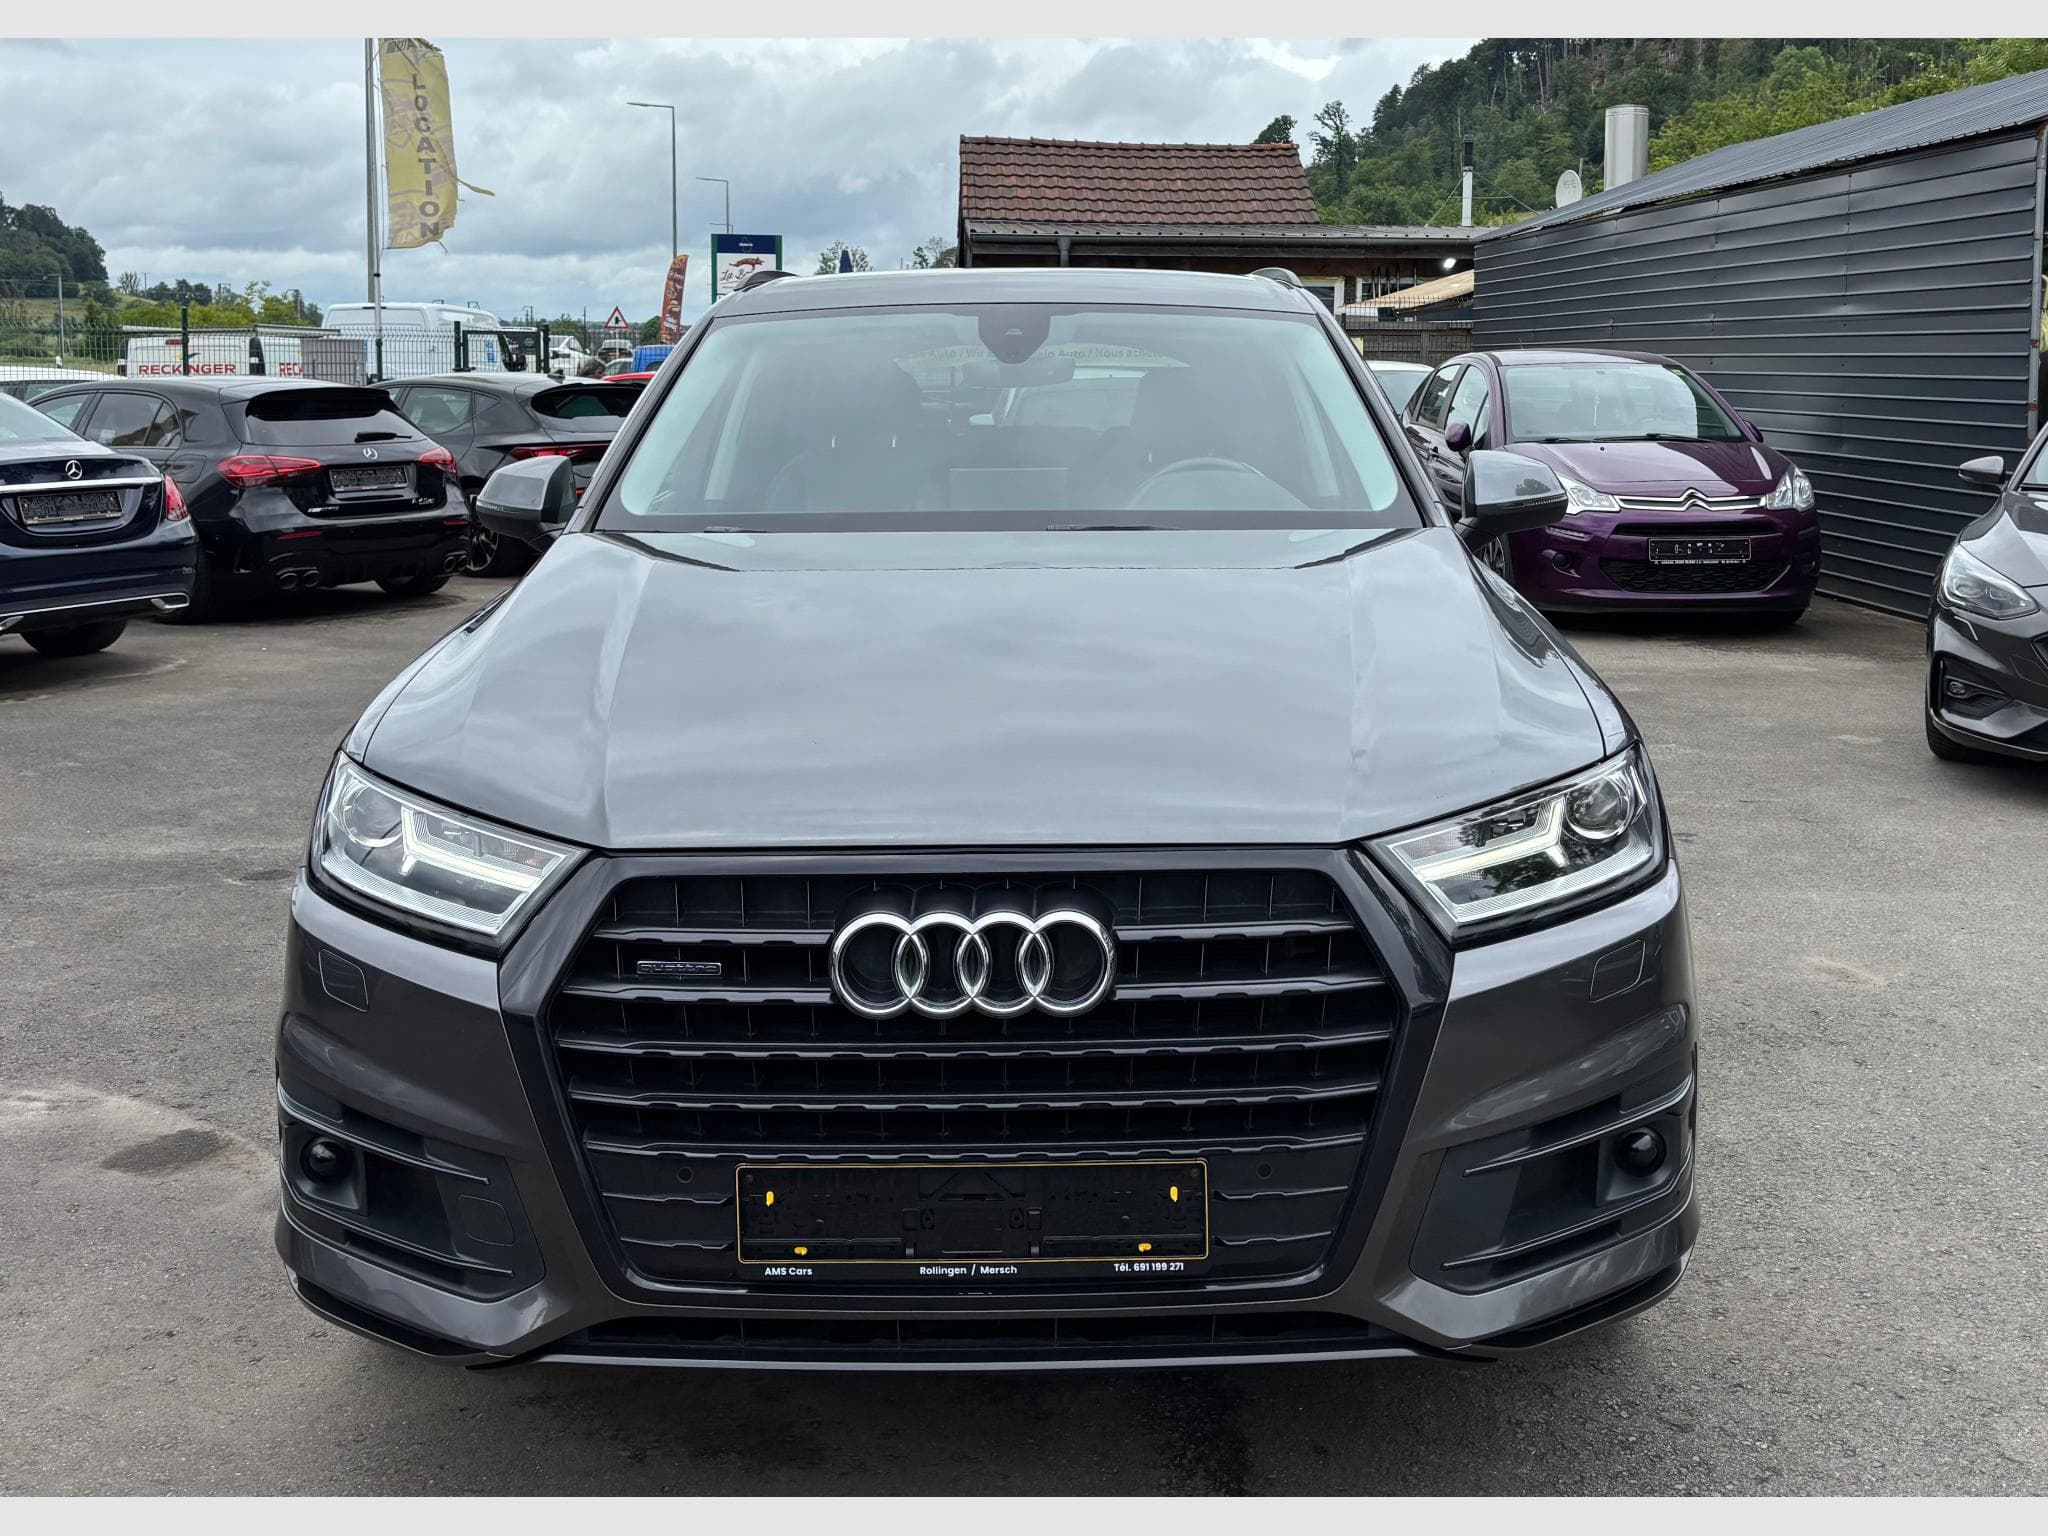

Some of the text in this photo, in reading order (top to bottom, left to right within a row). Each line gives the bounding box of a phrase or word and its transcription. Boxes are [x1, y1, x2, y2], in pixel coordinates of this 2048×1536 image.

[412, 73, 440, 238] LOCATION
[139, 364, 237, 375] RECKNGER
[764, 1262, 1184, 1277] AMS Cars Rollingen / Mersch Tél. 691 199 271
